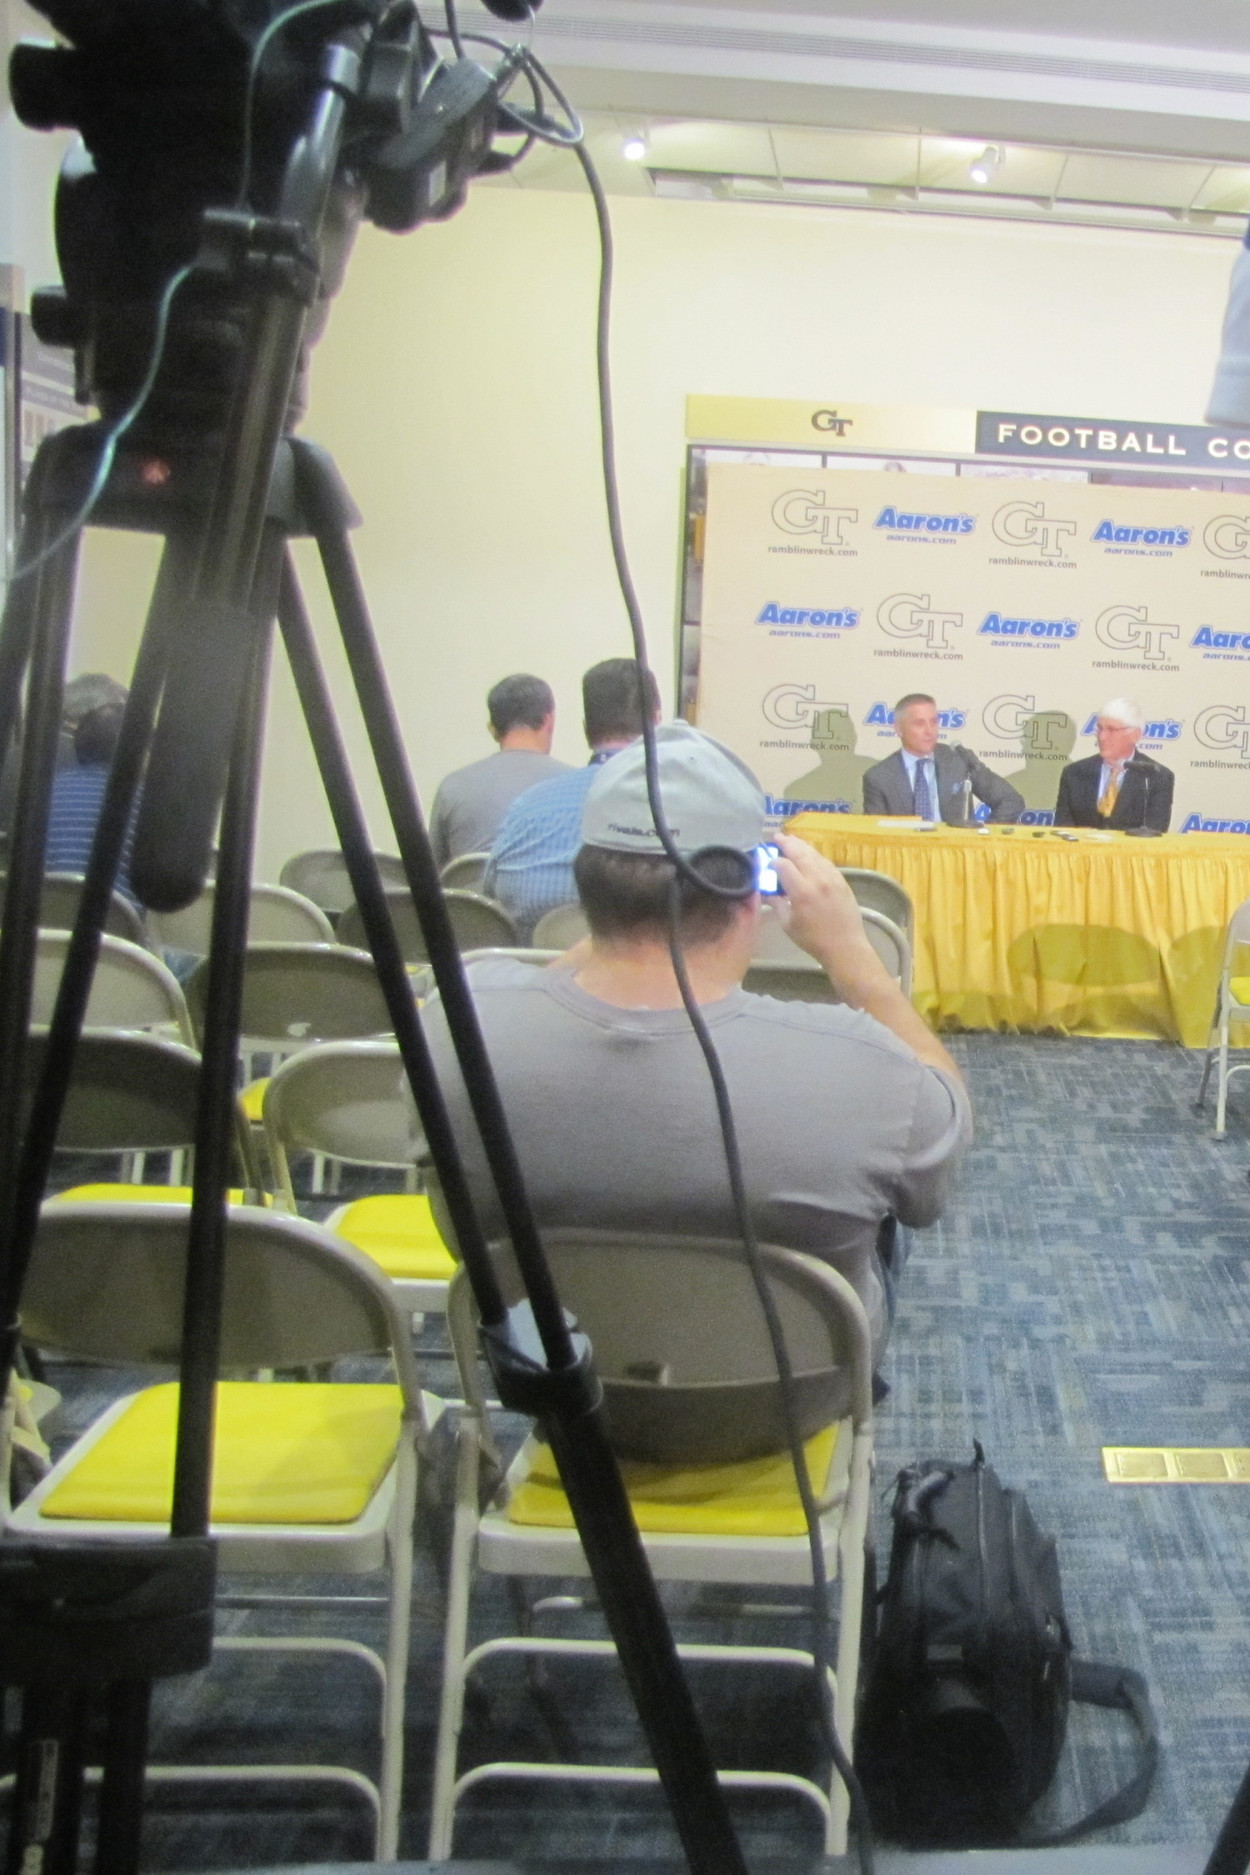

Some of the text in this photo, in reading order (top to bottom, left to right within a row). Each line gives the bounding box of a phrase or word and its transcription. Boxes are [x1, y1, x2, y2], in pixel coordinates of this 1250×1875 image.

[811, 409, 853, 437] GT
[997, 423, 1186, 456] FOOTBALL
[771, 489, 859, 546] GT
[873, 506, 976, 535] Aaron's
[991, 500, 1077, 558] GT
[1091, 519, 1191, 548] Aaron's
[768, 544, 858, 557] ramblinwreck.com
[988, 556, 1077, 569] ramblinwreck.com
[756, 602, 860, 629] Aaron's
[876, 592, 963, 649] GT
[977, 612, 1079, 640] Aaron's
[1095, 605, 1180, 661] GT
[873, 648, 963, 661] ramblinwreck.com
[1092, 659, 1180, 672] ramblinwreck.com
[762, 683, 849, 740] GT
[982, 694, 1067, 749] GT
[760, 739, 849, 751] ramblinwreck.com
[979, 749, 1067, 761] ramblinwreck.com
